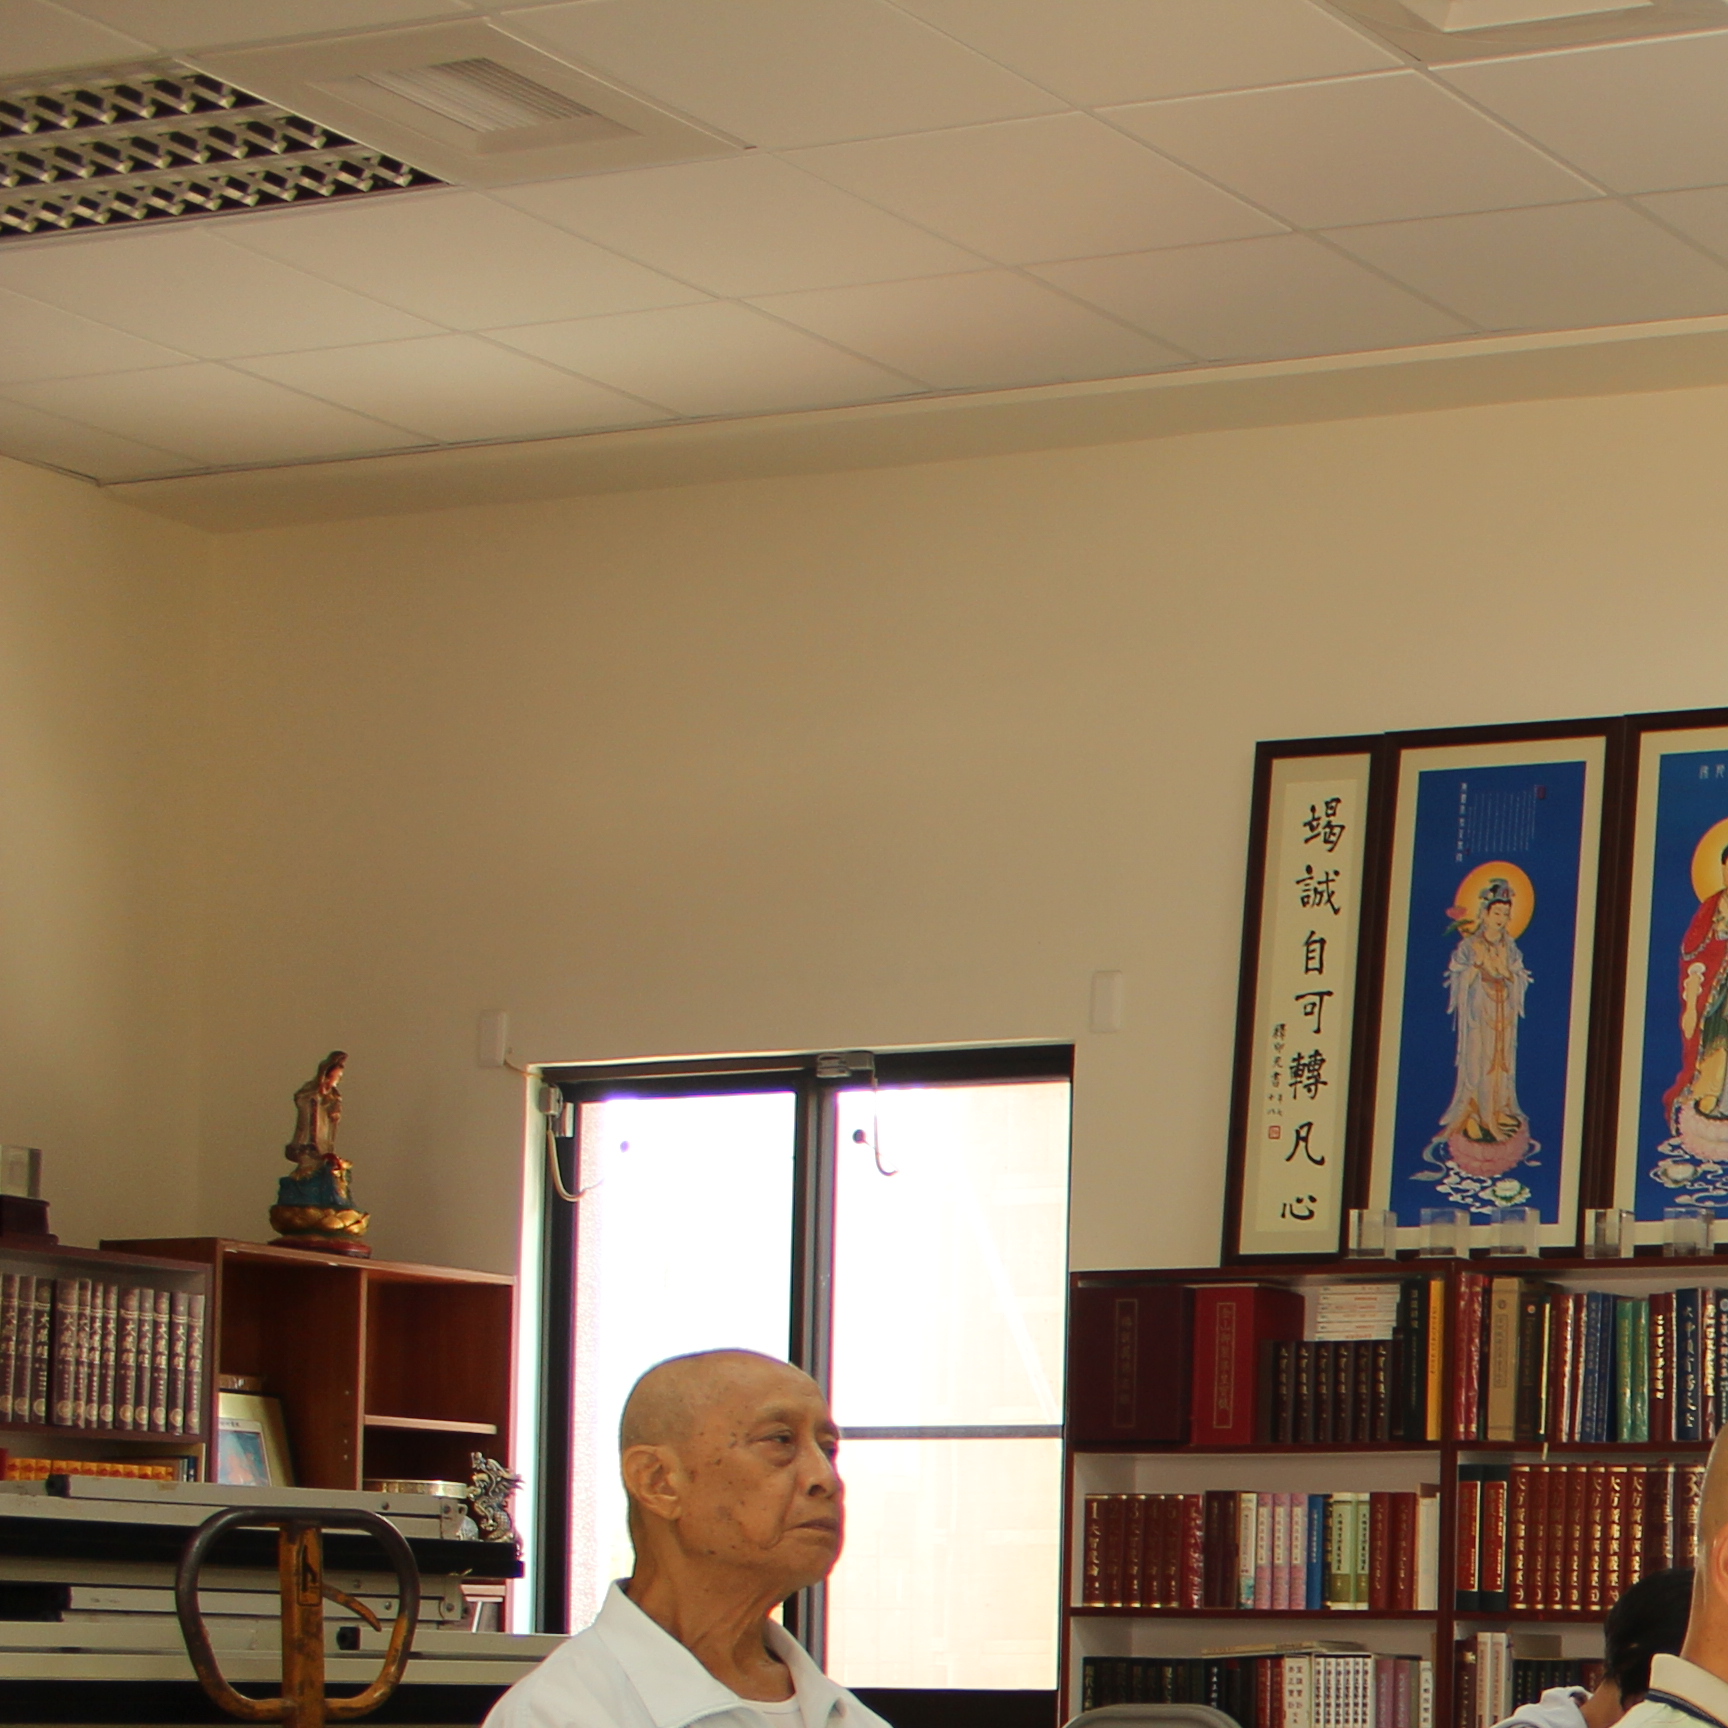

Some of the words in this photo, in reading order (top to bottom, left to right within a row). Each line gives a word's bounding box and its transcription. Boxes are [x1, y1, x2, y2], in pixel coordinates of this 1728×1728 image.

[1281, 797, 1346, 1220] 竭誠自可轉凡心
